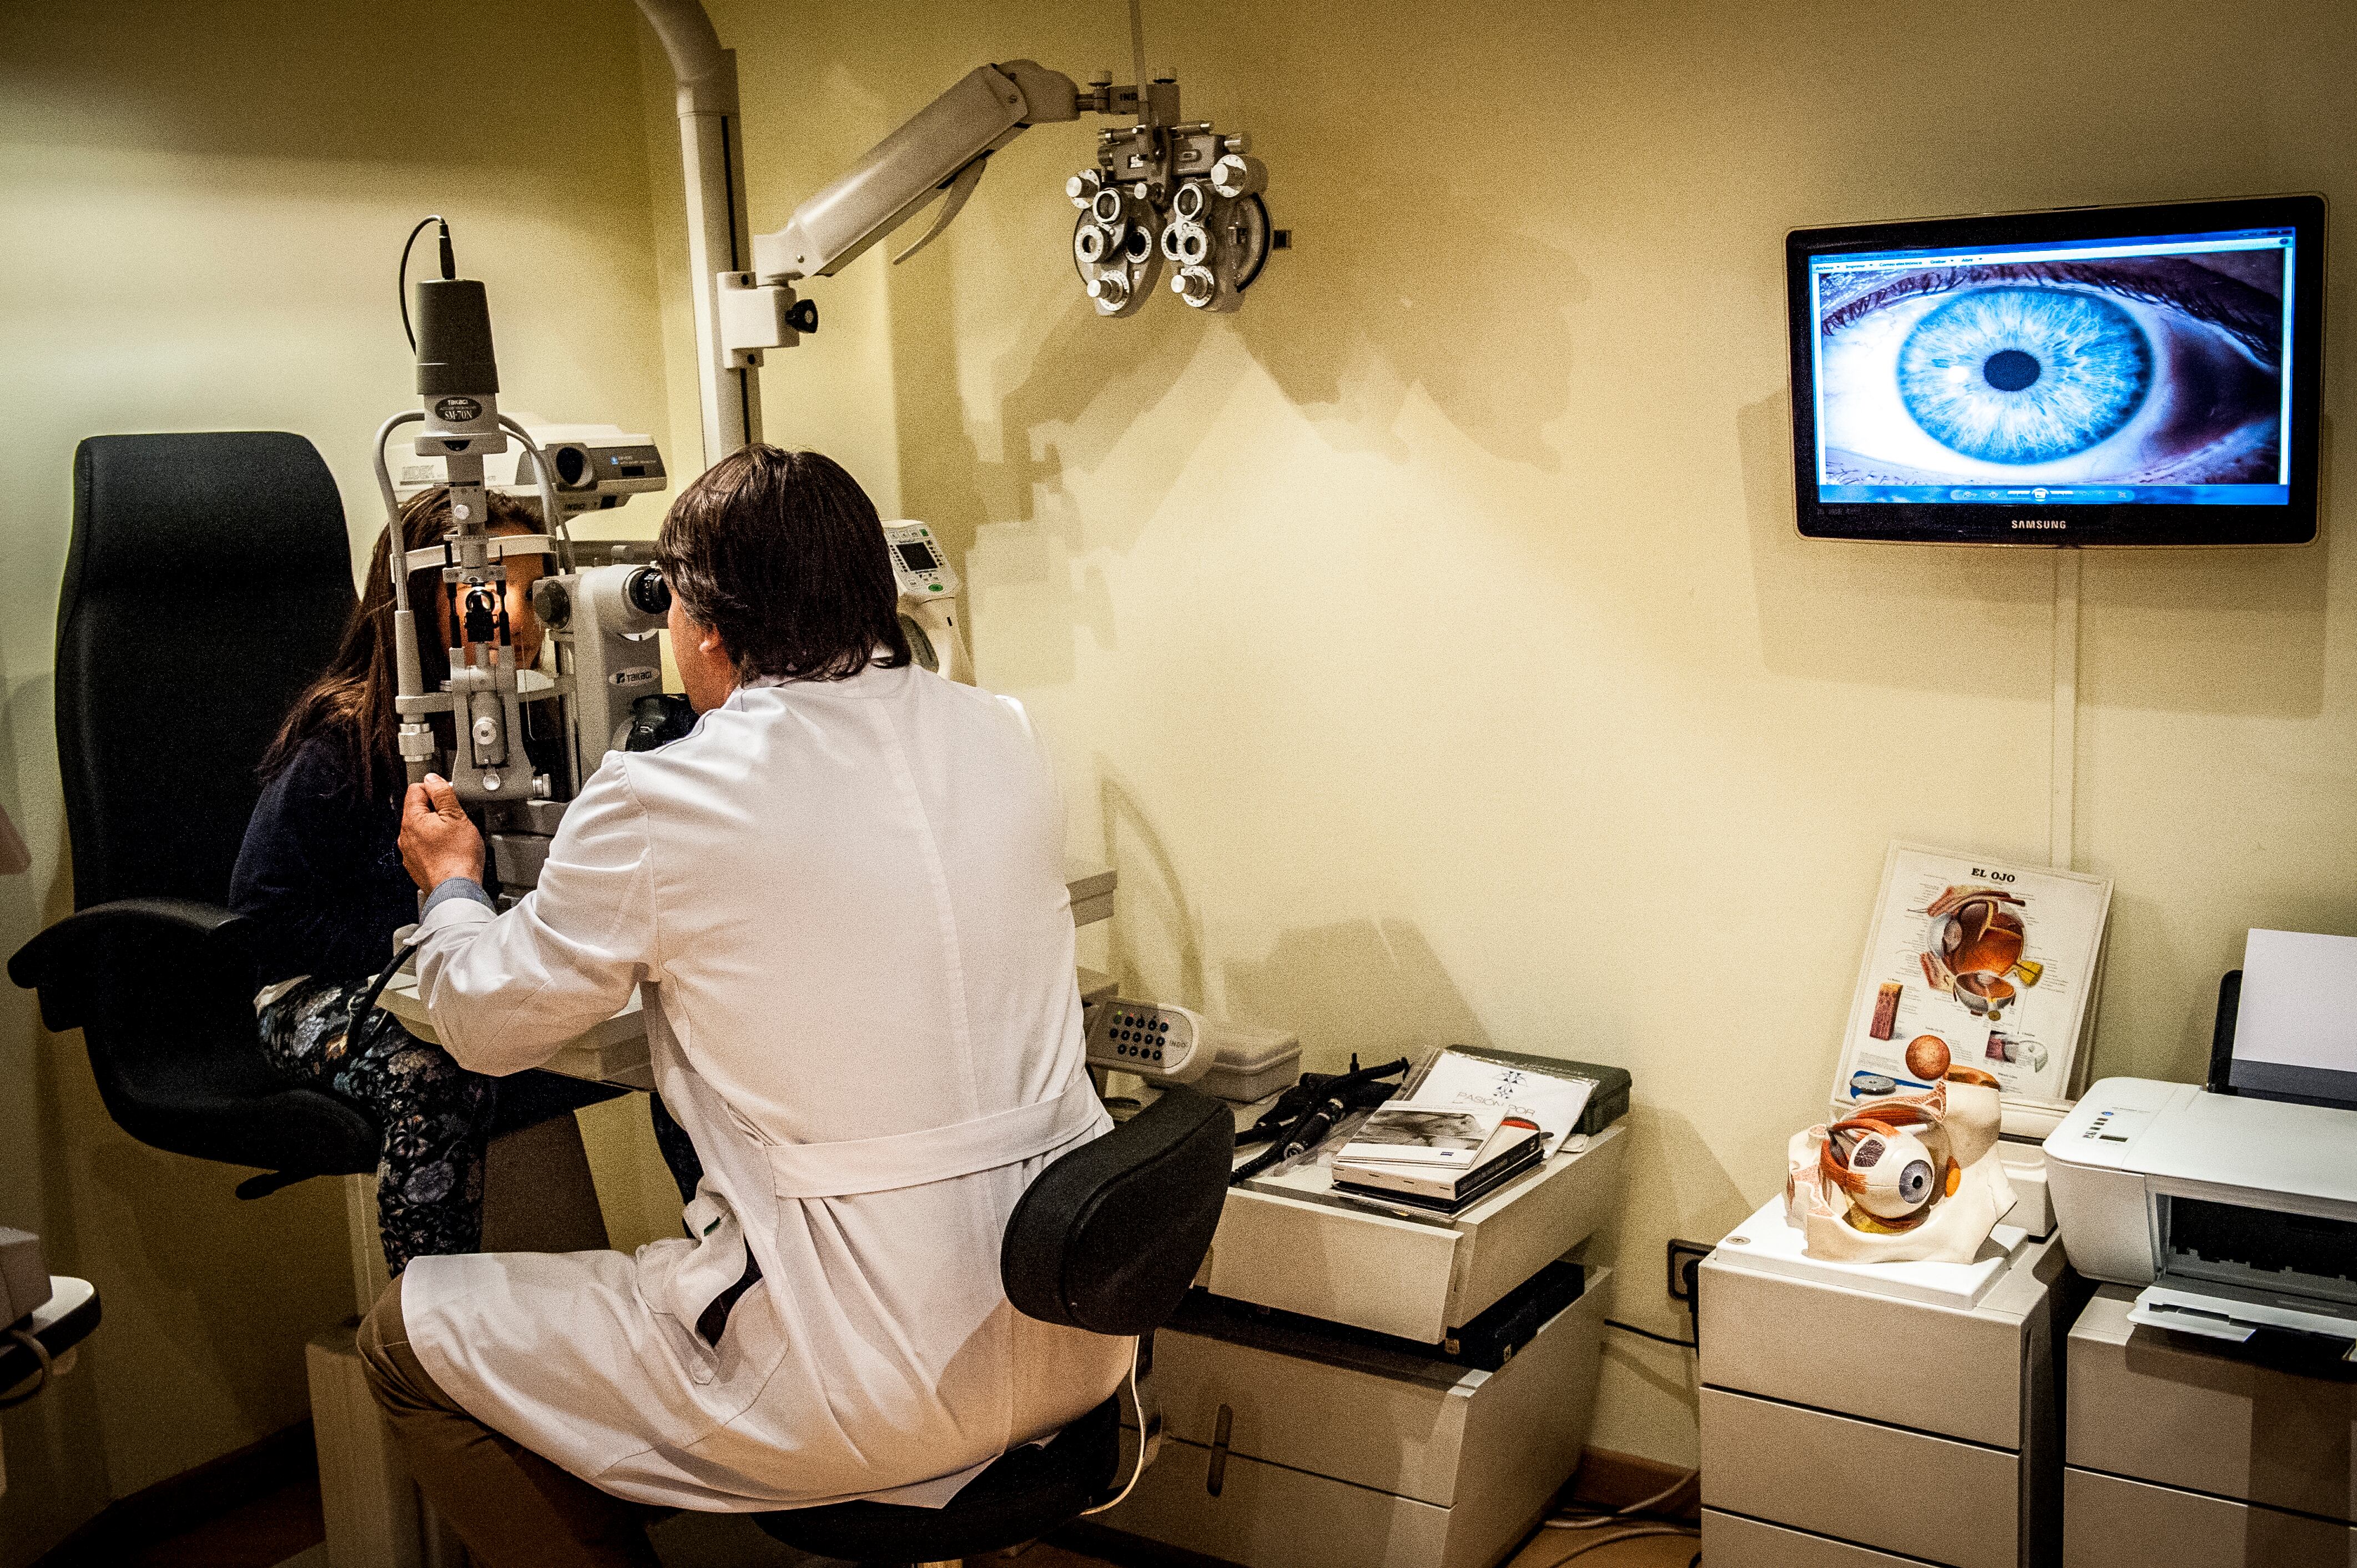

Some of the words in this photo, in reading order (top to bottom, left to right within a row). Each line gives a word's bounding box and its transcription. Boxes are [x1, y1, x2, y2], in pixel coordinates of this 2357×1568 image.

[1119, 92, 1138, 101] IND
[2011, 520, 2066, 529] SAMSUNG
[1971, 868, 1987, 878] EL
[1991, 871, 2015, 883] OJO
[1508, 1103, 1535, 1117] POR
